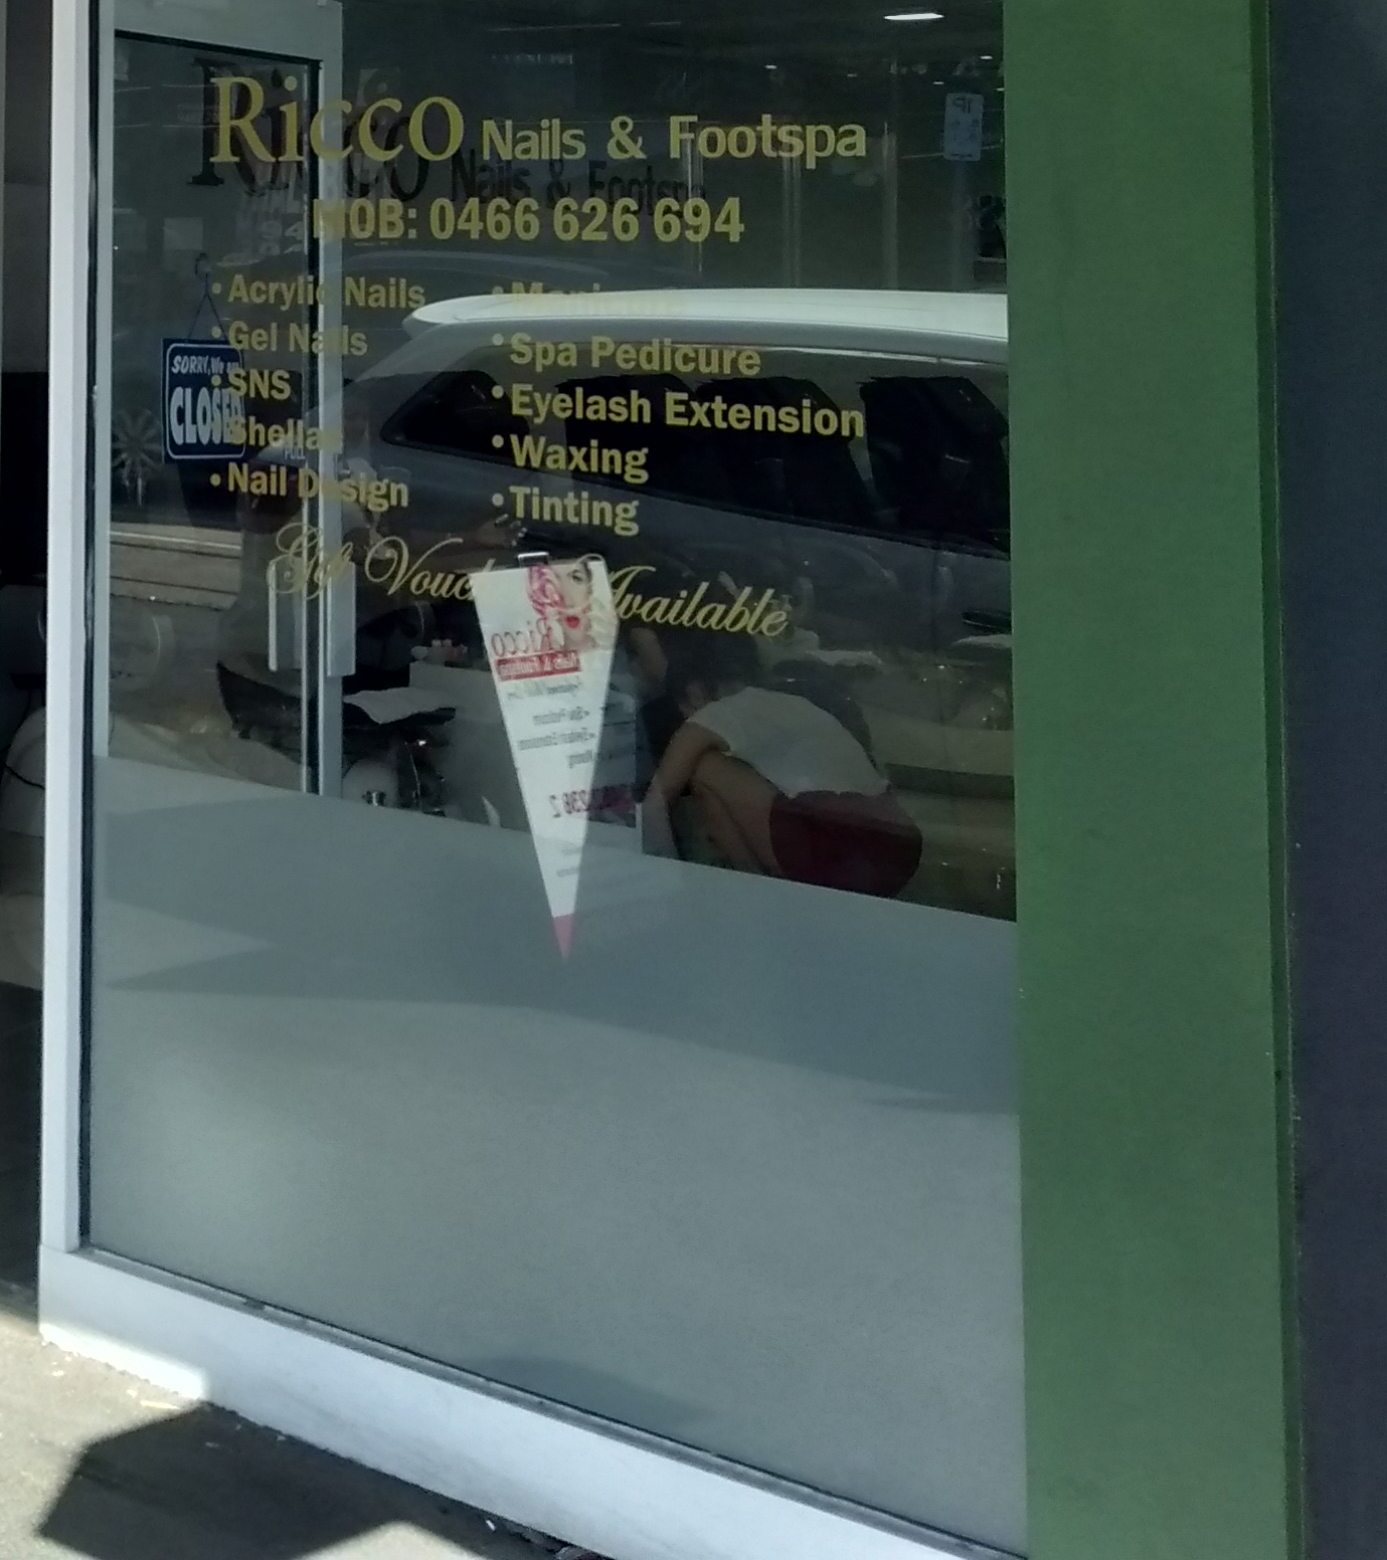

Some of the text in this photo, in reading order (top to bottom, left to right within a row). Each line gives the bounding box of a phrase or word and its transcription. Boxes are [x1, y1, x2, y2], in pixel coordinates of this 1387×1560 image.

[210, 76, 866, 170] Ricco Nails & Footspa
[430, 197, 545, 241] 0466
[553, 197, 640, 242] 626
[652, 197, 744, 243] 694
[345, 276, 425, 310] Nails
[228, 320, 369, 356] Gel Nals
[509, 333, 762, 376] Spa Pedicure
[228, 368, 291, 400] SNS
[169, 385, 242, 446] CLOSED
[229, 415, 343, 450] Shella
[511, 384, 864, 438] Eyelash Extension
[510, 436, 648, 484] Waxing
[228, 461, 409, 512] Nail Dsign
[510, 486, 639, 536] Tinting
